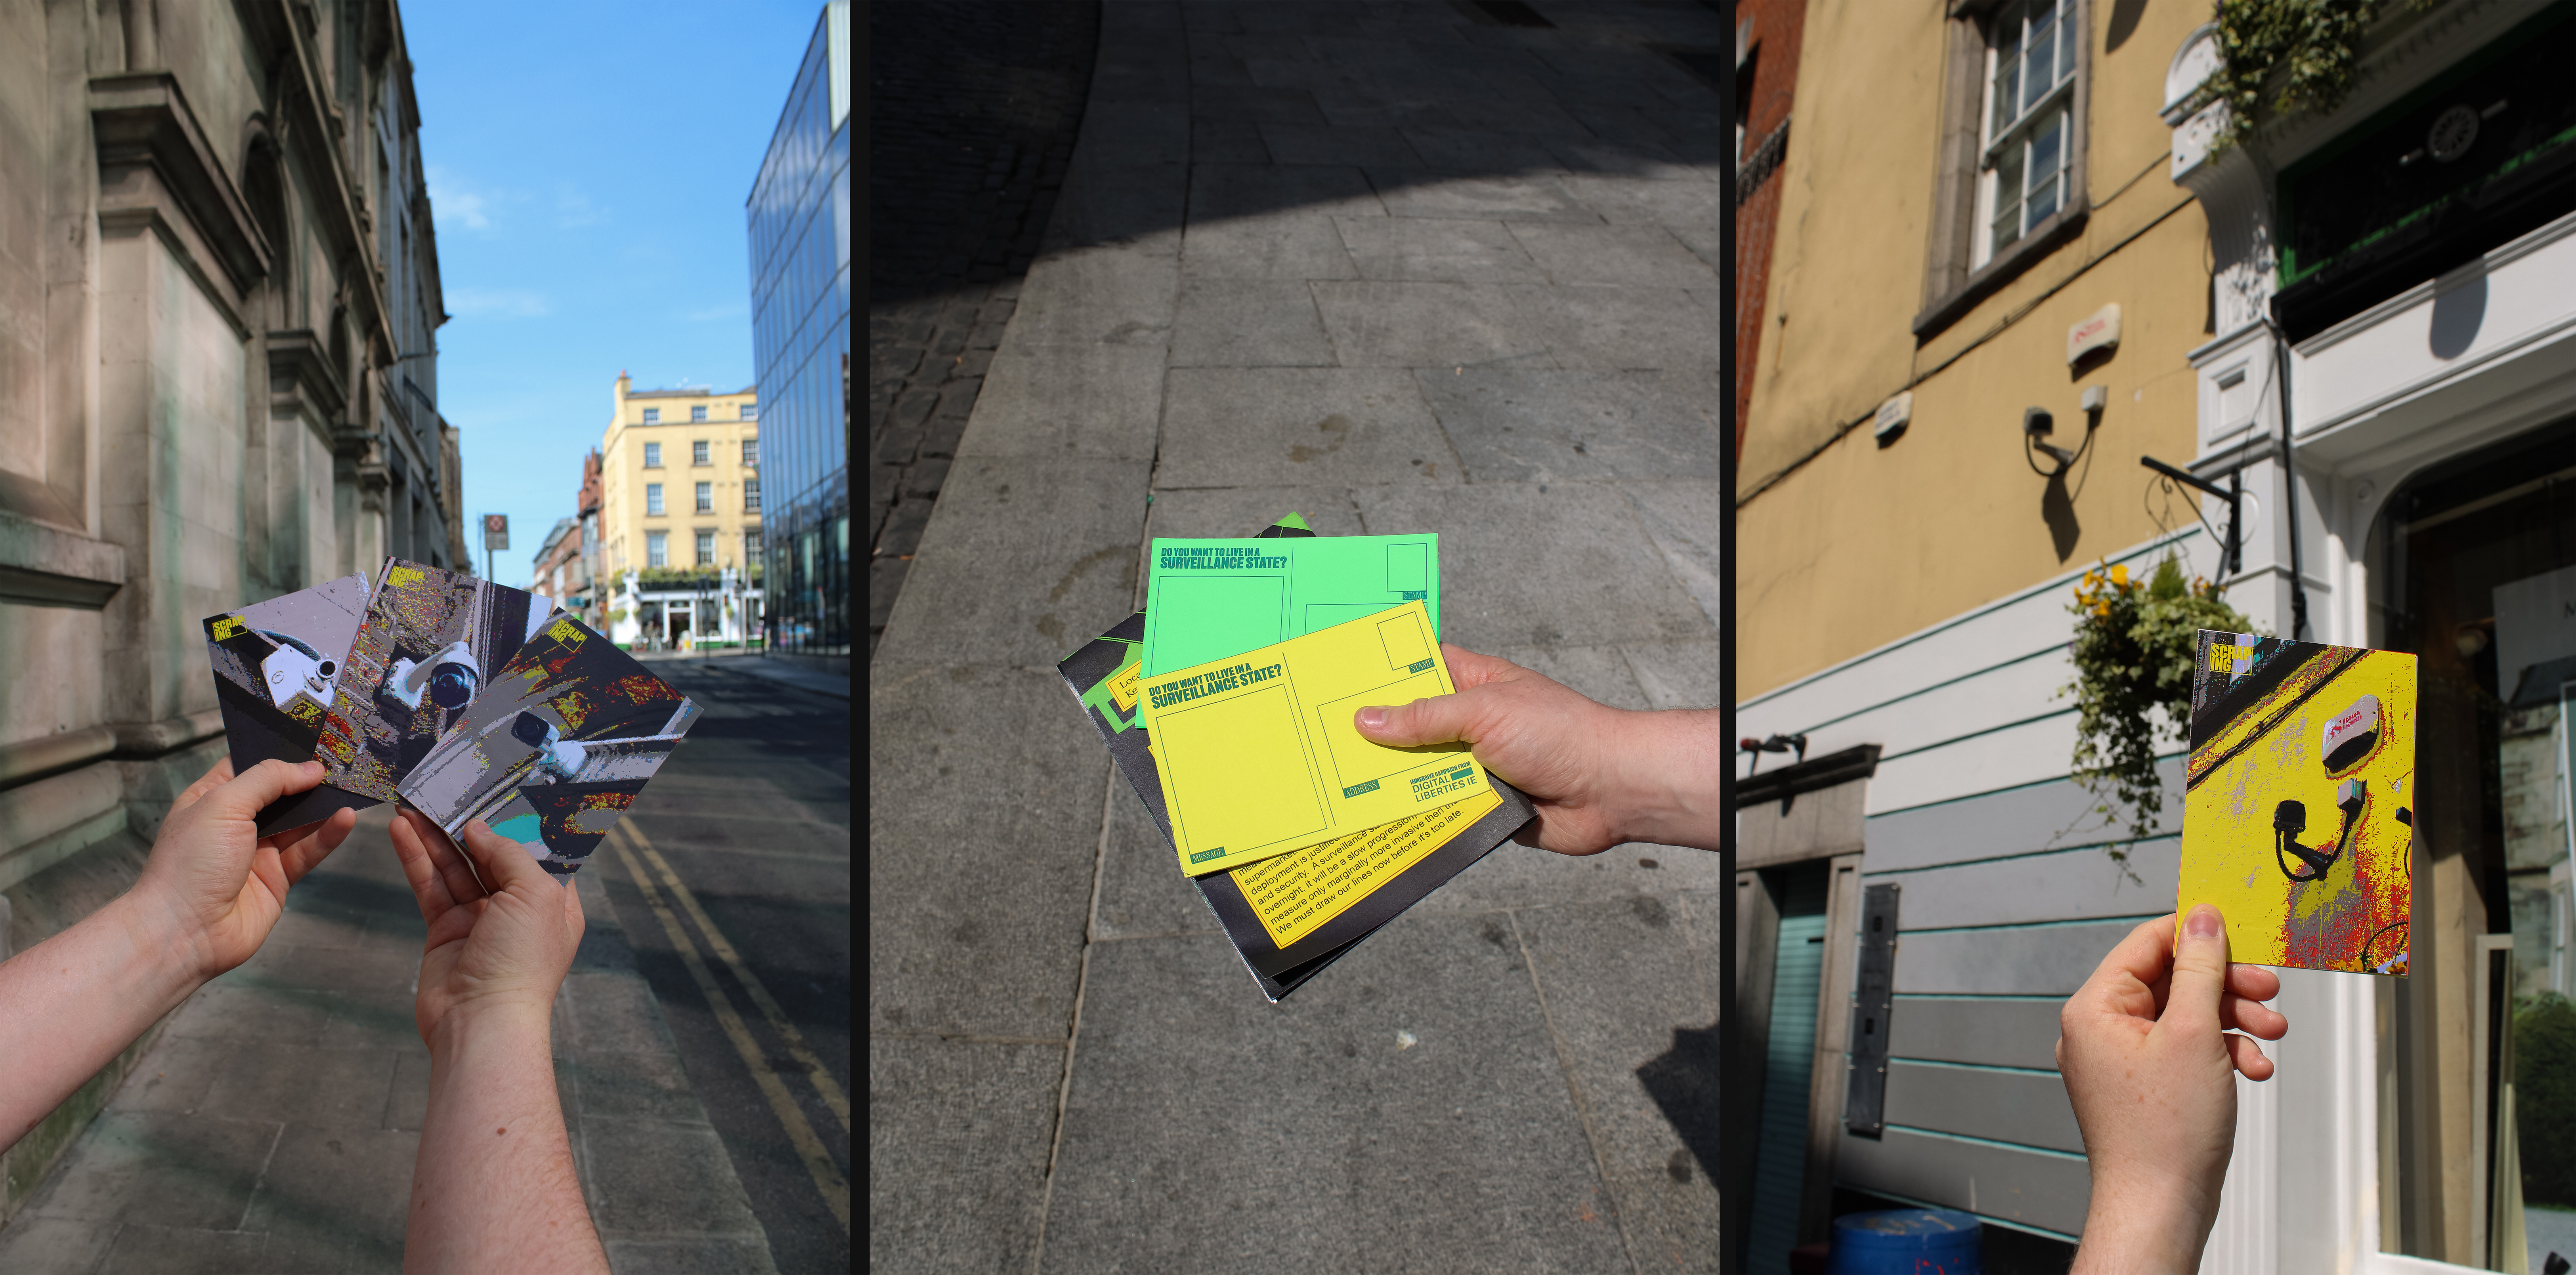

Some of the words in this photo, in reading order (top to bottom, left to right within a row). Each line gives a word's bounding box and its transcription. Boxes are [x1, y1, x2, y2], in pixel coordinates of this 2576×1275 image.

[1162, 548, 1172, 556] DO
[1174, 548, 1190, 556] YOU
[1191, 548, 1213, 556] WANT
[1215, 548, 1225, 556] TO
[1226, 548, 1243, 556] LIVE
[1245, 547, 1253, 556] IN
[1254, 547, 1260, 556] A
[1160, 556, 1244, 569] SURVEILLANCE
[1246, 556, 1287, 569] STATE?
[389, 575, 406, 587] ING
[392, 567, 423, 582] SCRAP
[214, 616, 244, 632] SCRAP
[556, 620, 585, 642] SCRAP
[215, 628, 231, 640] ING
[549, 627, 567, 642] ING
[2211, 644, 2251, 661] SCRAP
[1410, 659, 1432, 672] STAMP
[2211, 657, 2232, 672] ING
[1119, 672, 1141, 689] Loca
[1148, 686, 1161, 697] DO
[1161, 681, 1179, 693] YOU
[1179, 675, 1203, 689] WANT
[1204, 672, 1215, 682] TO
[1216, 667, 1235, 679] LIVE
[1234, 664, 1244, 674] IN
[1246, 663, 1252, 672] A
[1151, 675, 1240, 709] SURVEILLANCE
[1239, 664, 1282, 686] STATE?
[1126, 687, 1139, 698] Ke
[1410, 772, 1435, 785] IMMERSIVE
[1435, 765, 1458, 777] CAMPAIGN
[1458, 761, 1471, 770] FROM
[1346, 781, 1377, 797] ADDRESS
[1412, 775, 1451, 793] DIGITAL
[1415, 780, 1466, 802] LIBERTIES
[1467, 776, 1477, 786] IE
[1192, 849, 1223, 862] MESSAGE
[1244, 852, 1298, 885] supermarket.
[1257, 890, 1274, 905] and
[1275, 869, 1309, 894] security.
[1312, 862, 1320, 870] A
[1320, 832, 1367, 864] surveillance
[1271, 899, 1307, 925] measure
[1309, 886, 1326, 900] only
[1327, 858, 1368, 889] marginally
[1369, 843, 1391, 860] more
[1390, 821, 1425, 845] invasive
[1424, 808, 1444, 823] then
[1276, 923, 1292, 934] We
[1293, 907, 1315, 924] must
[1315, 893, 1336, 910] draw
[1337, 883, 1351, 895] our
[1351, 870, 1372, 886] lines
[1373, 857, 1390, 872] now
[1390, 840, 1418, 860] before
[1430, 822, 1445, 833] too
[1444, 810, 1464, 823] late.
[1251, 860, 1299, 895] deployment
[1264, 886, 1306, 914] overnight,
[1305, 880, 1313, 888] it
[1312, 870, 1327, 883] will
[1326, 864, 1339, 874] be
[1347, 845, 1366, 860] slow
